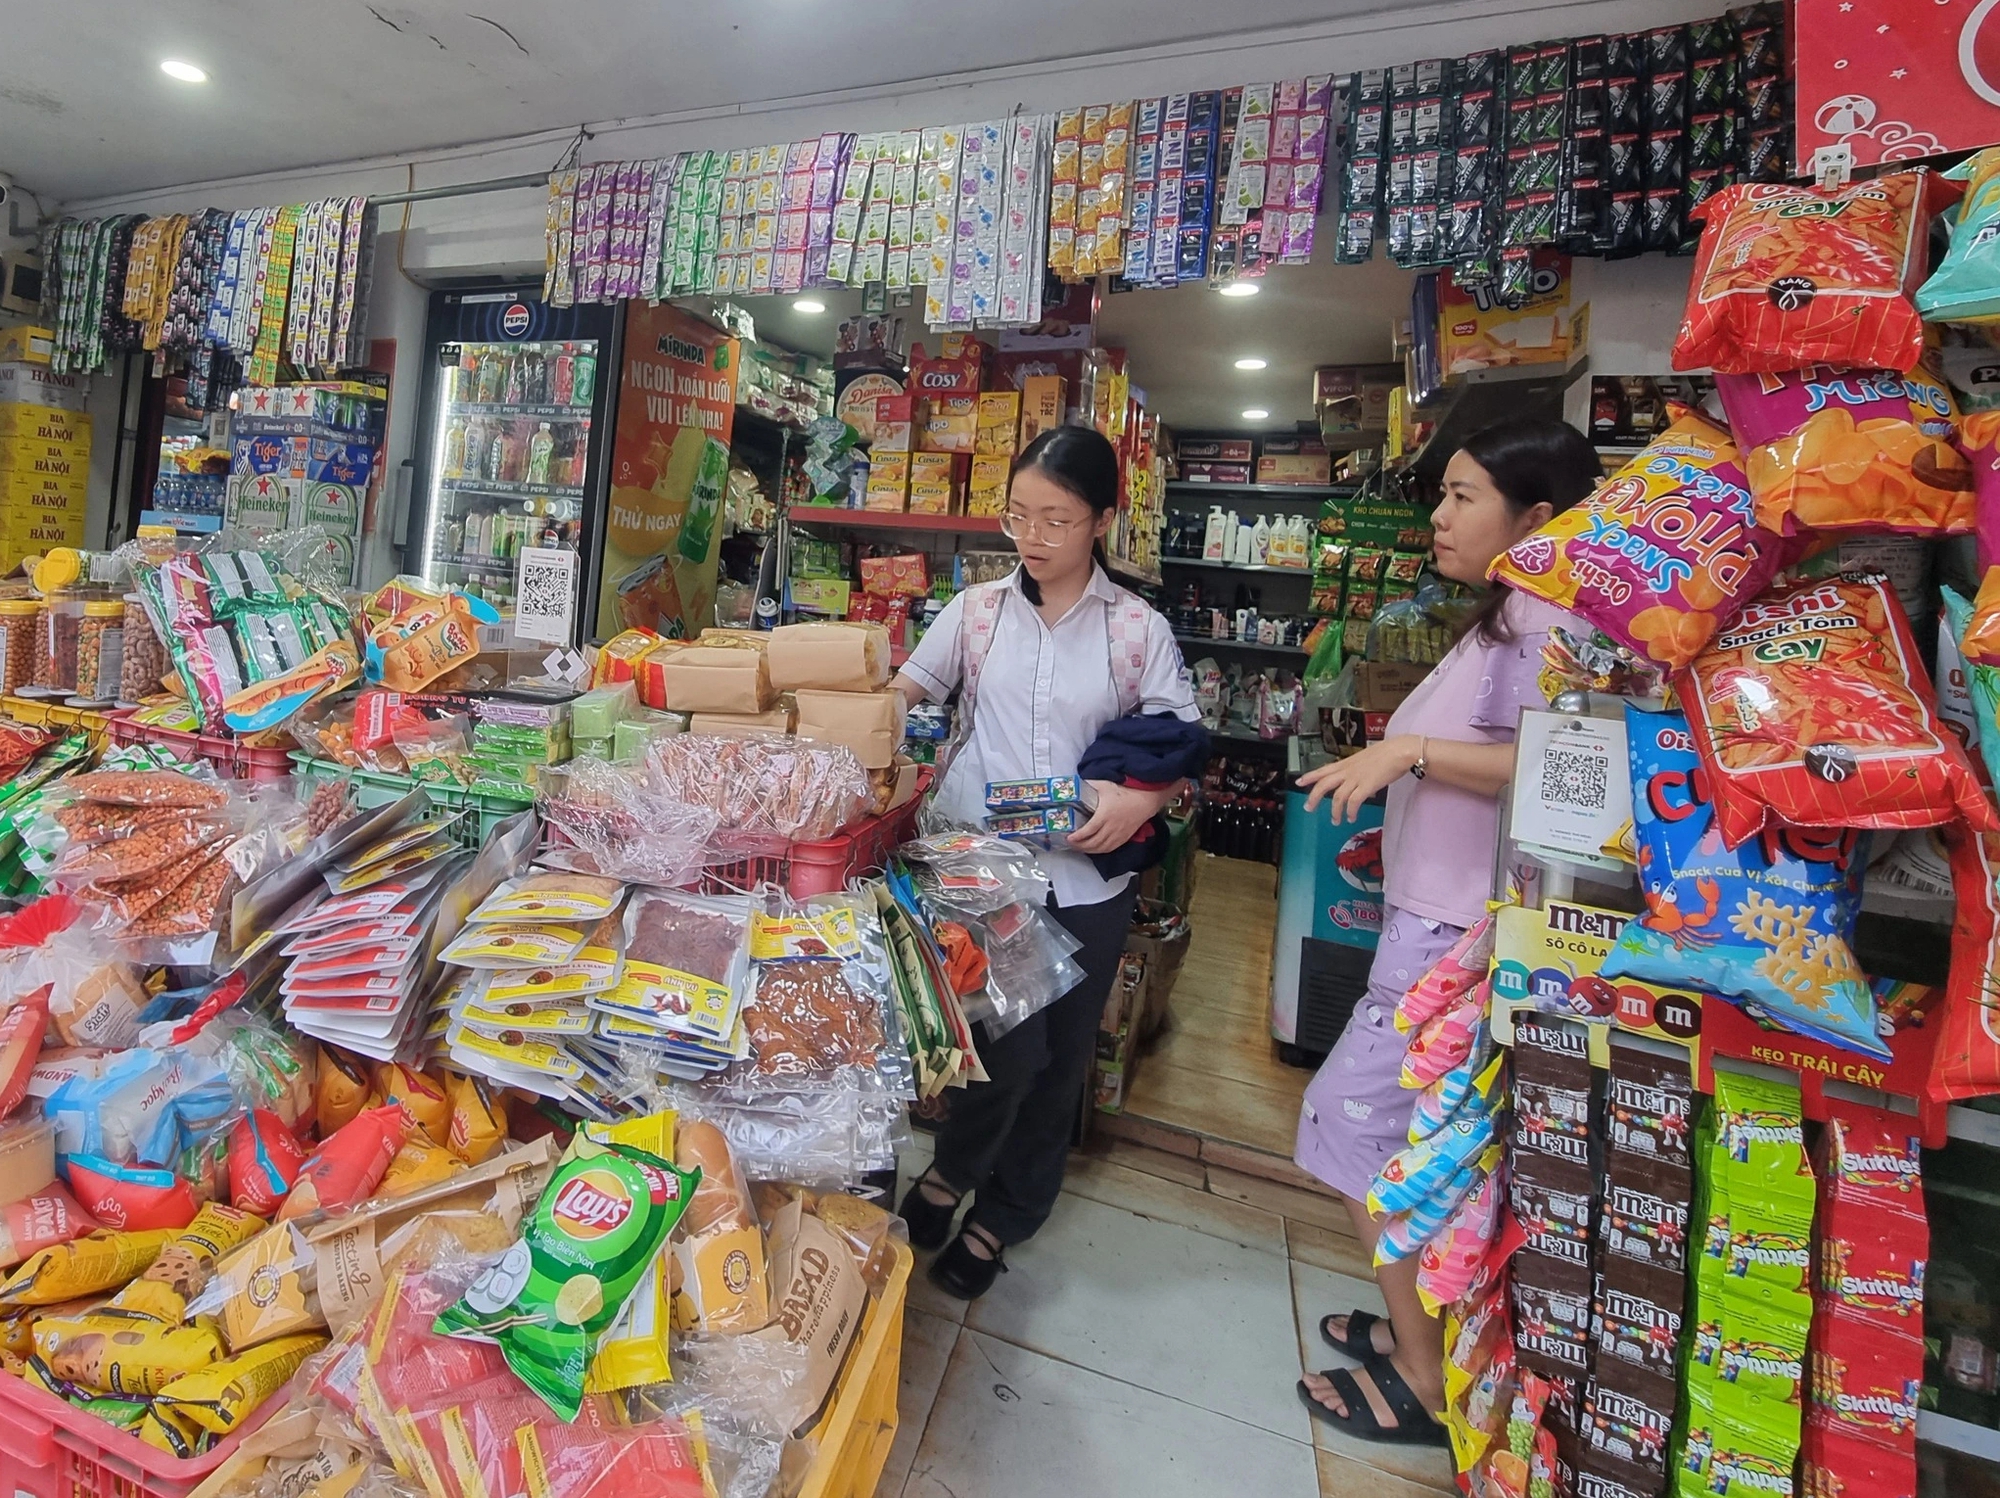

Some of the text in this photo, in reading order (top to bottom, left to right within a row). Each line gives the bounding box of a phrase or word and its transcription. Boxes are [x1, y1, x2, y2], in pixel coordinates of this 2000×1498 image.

[1778, 199, 1854, 218] Cay
[1464, 268, 1561, 312] Tio
[1778, 276, 1812, 288] RANG
[506, 316, 528, 324] PEPSI
[0, 368, 14, 380] NOI
[32, 369, 74, 388] HANOI
[632, 360, 674, 394] NGON
[922, 372, 961, 388] COSY
[850, 386, 894, 404] Danisa
[1323, 385, 1352, 394] VIFON
[647, 395, 672, 424] VUI
[949, 396, 970, 408] Tipo
[50, 414, 64, 424] BIA
[47, 448, 62, 457] BIA
[254, 442, 282, 462] Tiger
[332, 466, 356, 482] Tiger
[44, 481, 58, 490] BIA
[530, 485, 548, 493] PEPSI
[566, 488, 583, 496] PEPS
[238, 497, 289, 512] Heineken
[42, 514, 56, 524] BIA
[309, 512, 354, 525] Heineken
[646, 512, 682, 532] NGAY
[1570, 558, 1632, 606] Oishi
[1718, 616, 1857, 650] Snack Tôm
[1754, 637, 1828, 664] Cay
[1656, 728, 1697, 753] Ois
[1672, 866, 1712, 880] Snack
[1714, 866, 1742, 877] Cua
[1746, 869, 1760, 883] Vị
[1353, 908, 1382, 921] 180
[1548, 904, 1630, 940] m&m
[1546, 937, 1608, 958] SÔ CÔ LA
[33, 1069, 72, 1082] ANDW
[1752, 1045, 1884, 1086] KẸO TRÁI CÂY
[1730, 1124, 1803, 1144] Skittles
[382, 1136, 396, 1156] KIN
[1841, 1152, 1921, 1175] Skittles
[556, 1180, 628, 1228] Lay's
[576, 1250, 596, 1270] Nori
[1732, 1244, 1810, 1267] Skittles
[780, 1248, 830, 1342] BREAD
[1841, 1277, 1923, 1300] Skittles
[826, 1332, 842, 1358] FRESH
[1720, 1351, 1802, 1380] Skittles
[155, 1367, 165, 1389] KIN
[1836, 1394, 1918, 1420] Skittles
[1712, 1461, 1794, 1493] Skittles
